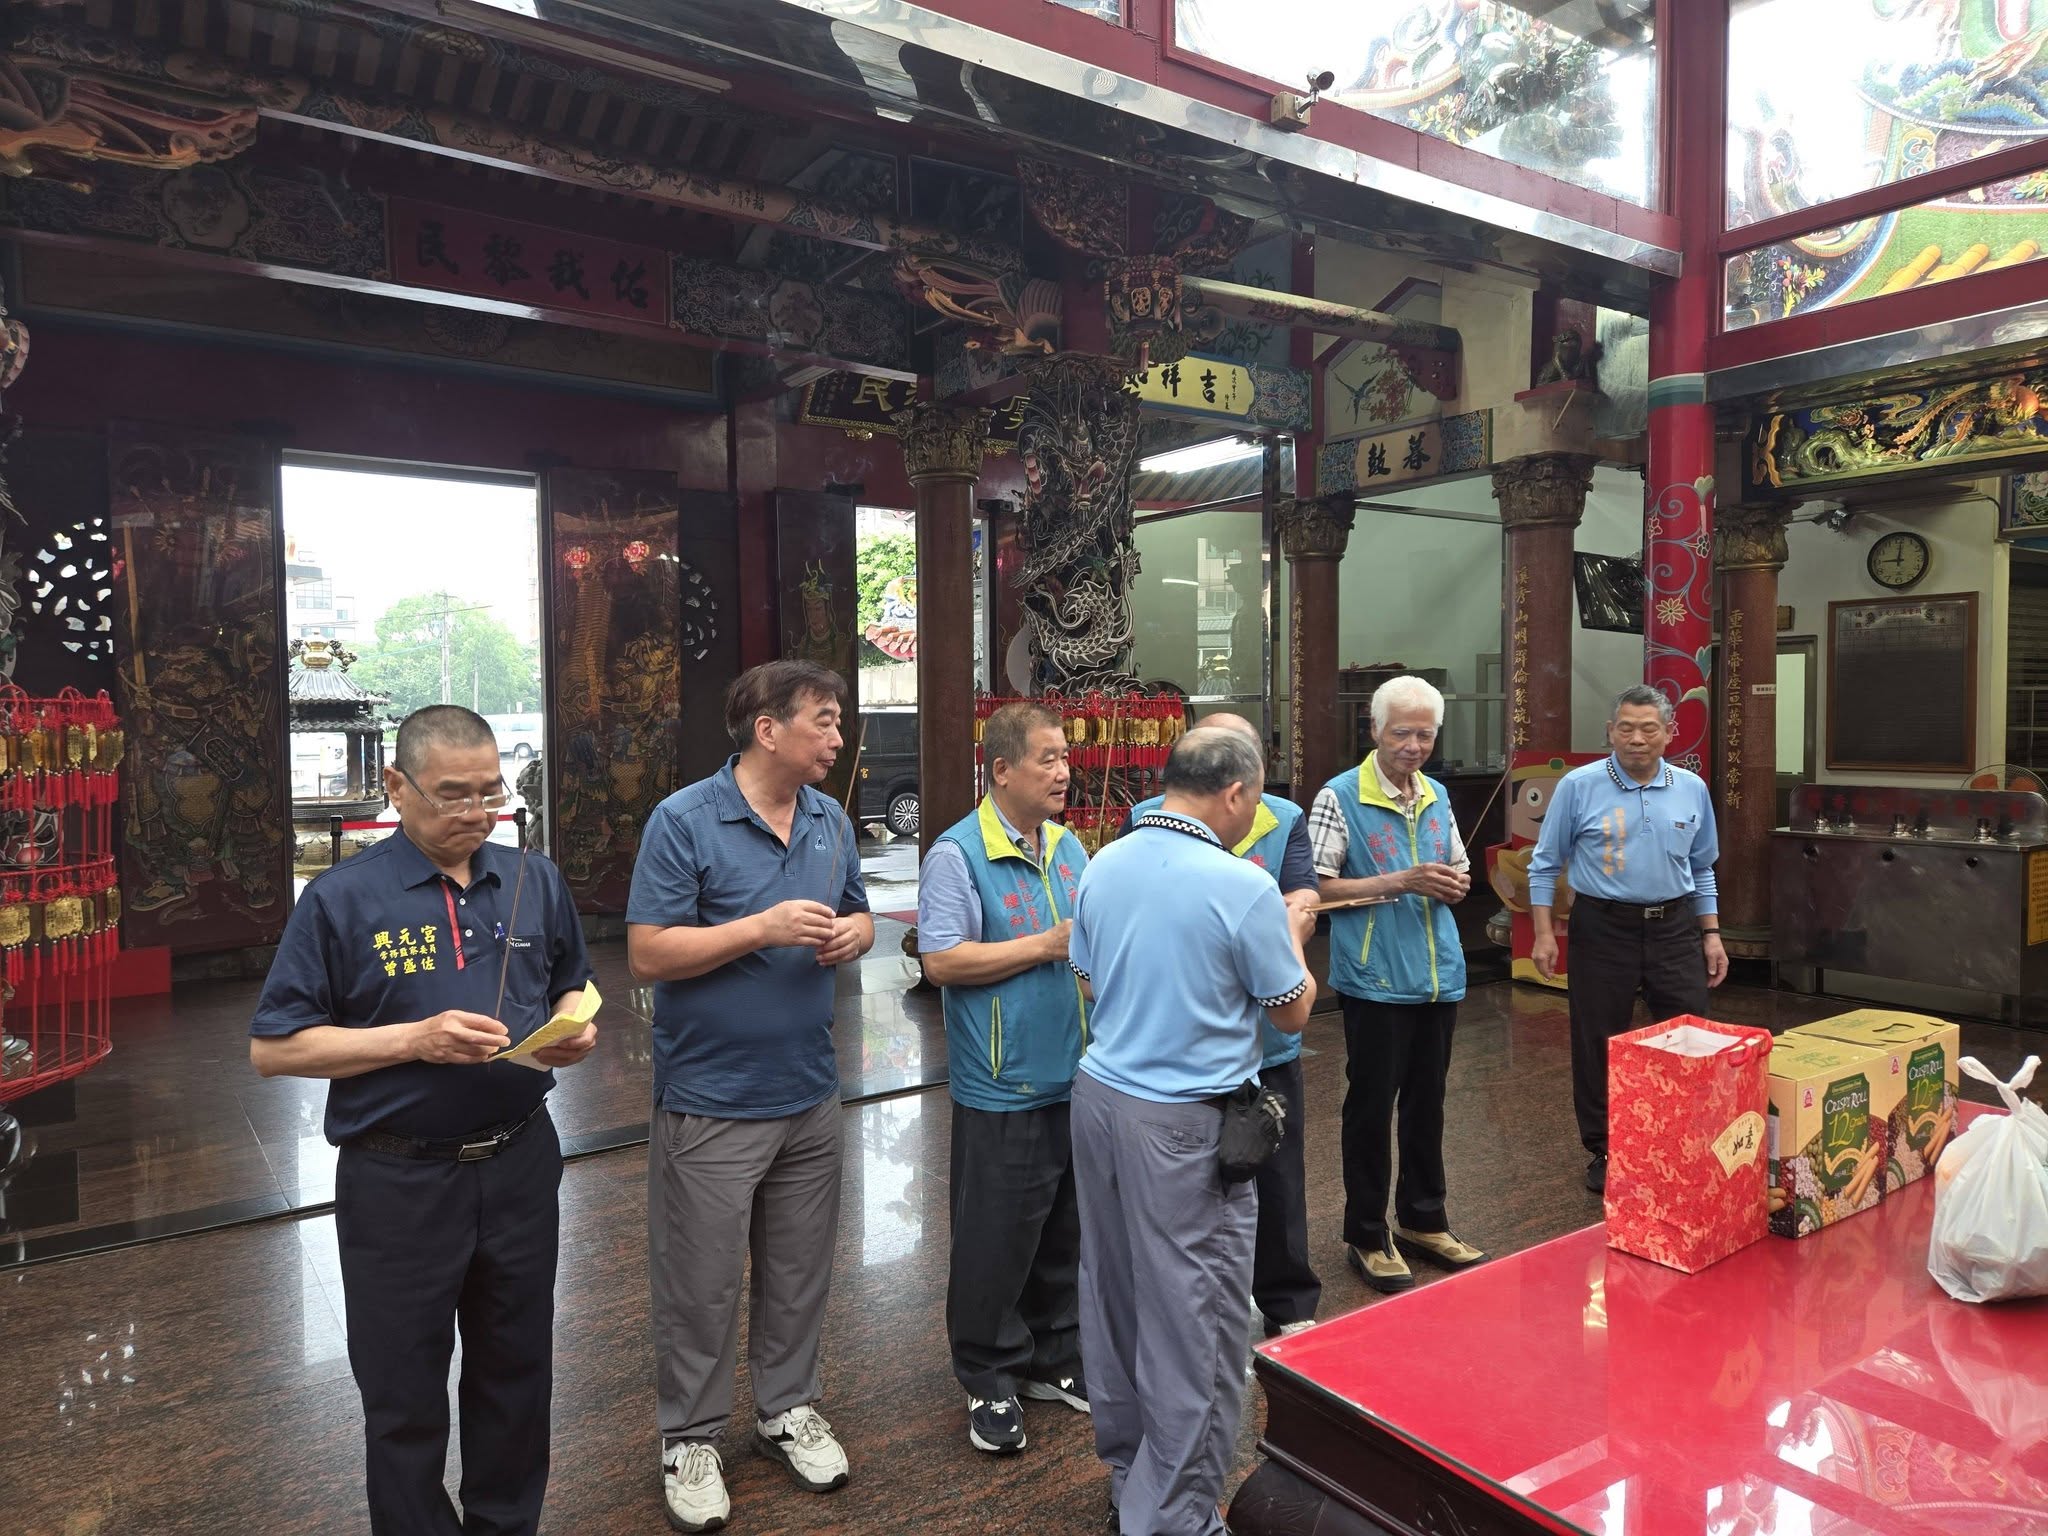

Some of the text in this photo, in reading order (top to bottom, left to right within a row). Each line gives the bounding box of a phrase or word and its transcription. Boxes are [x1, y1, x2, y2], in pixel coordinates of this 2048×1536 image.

[372, 924, 438, 951] 興元宮
[1911, 1078, 1934, 1111] 12
[1828, 1111, 1855, 1147] 12
